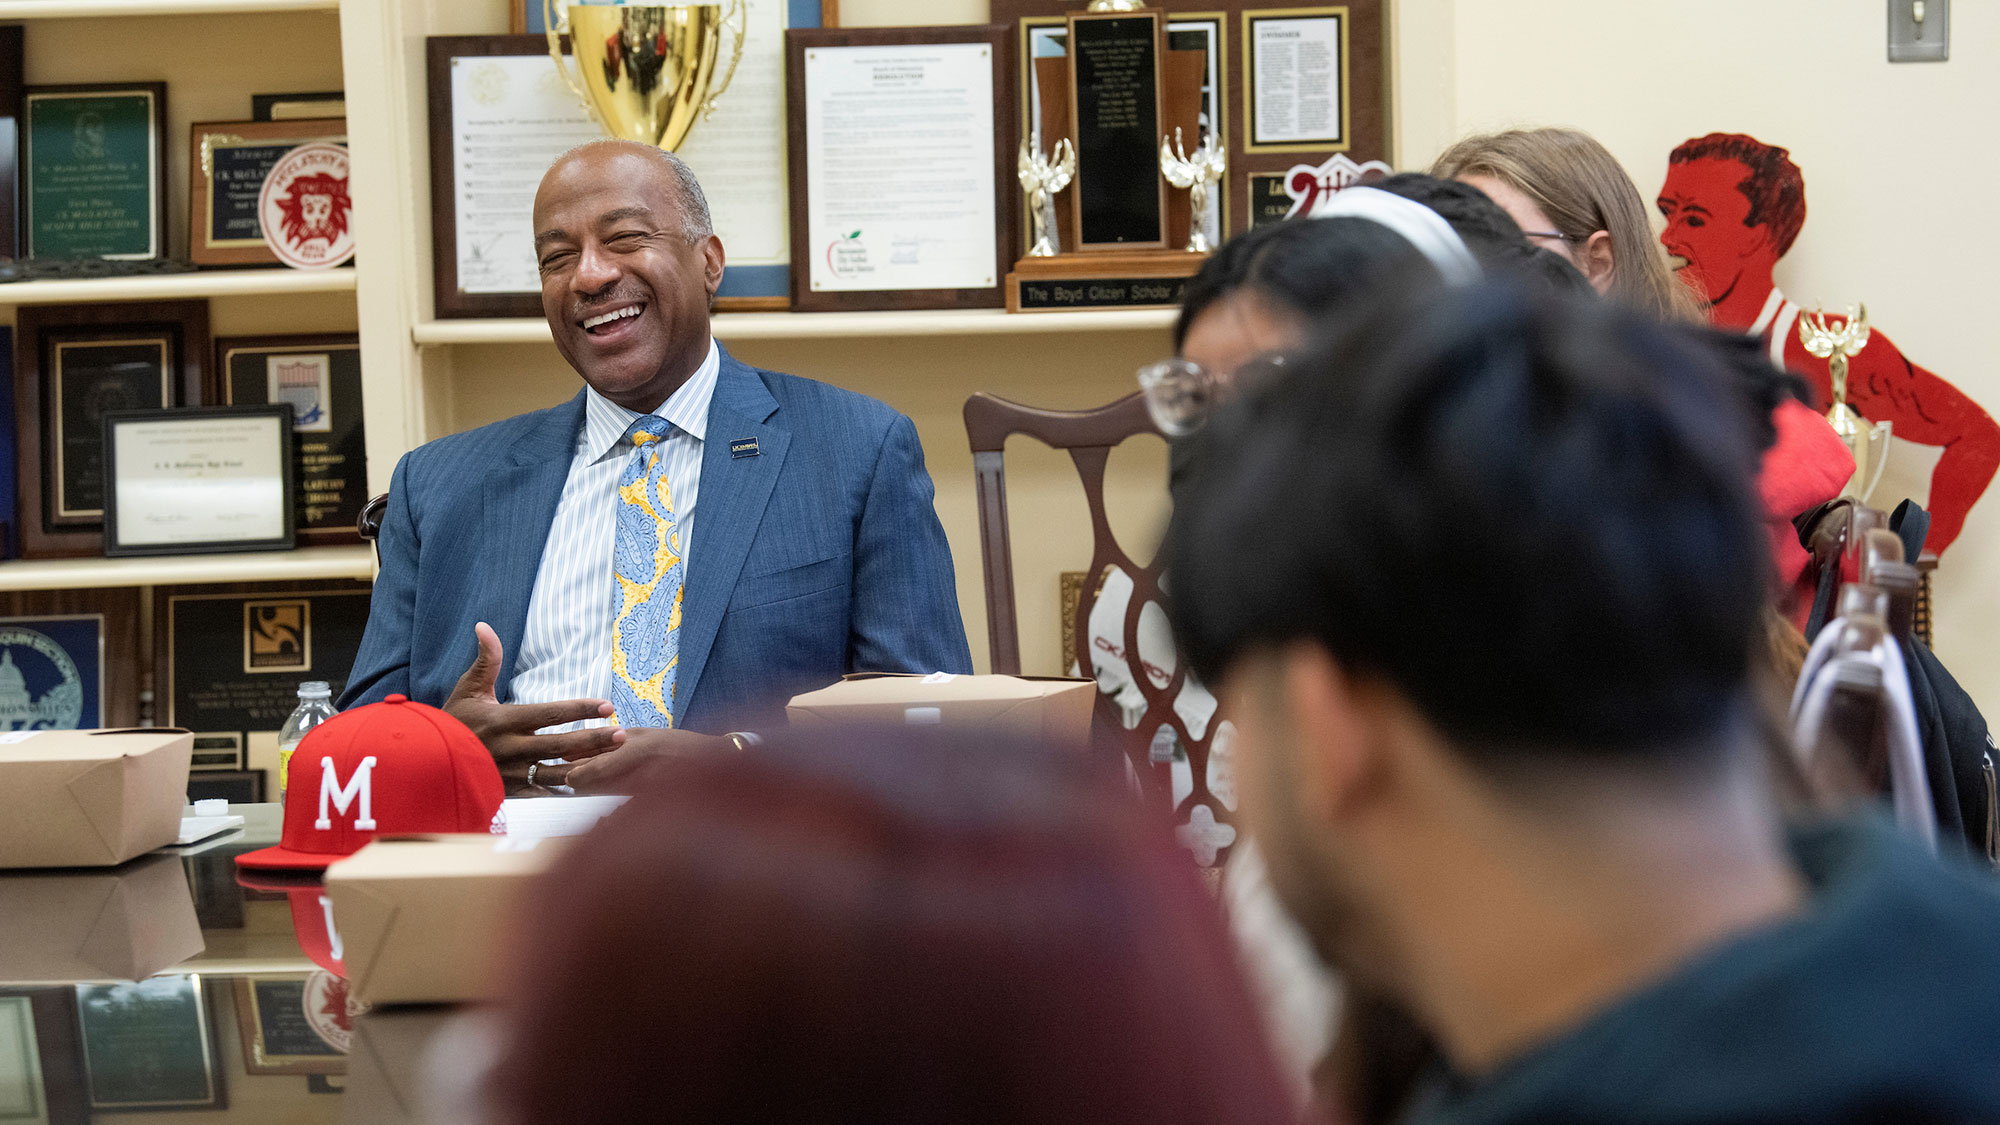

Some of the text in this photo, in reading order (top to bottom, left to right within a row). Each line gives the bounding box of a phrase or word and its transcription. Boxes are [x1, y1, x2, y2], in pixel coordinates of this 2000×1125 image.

[1027, 287, 1049, 302] The
[1054, 286, 1083, 303] Boyd
[1088, 284, 1126, 300] Citizen
[1131, 283, 1172, 299] Scholar
[314, 755, 377, 831] M
